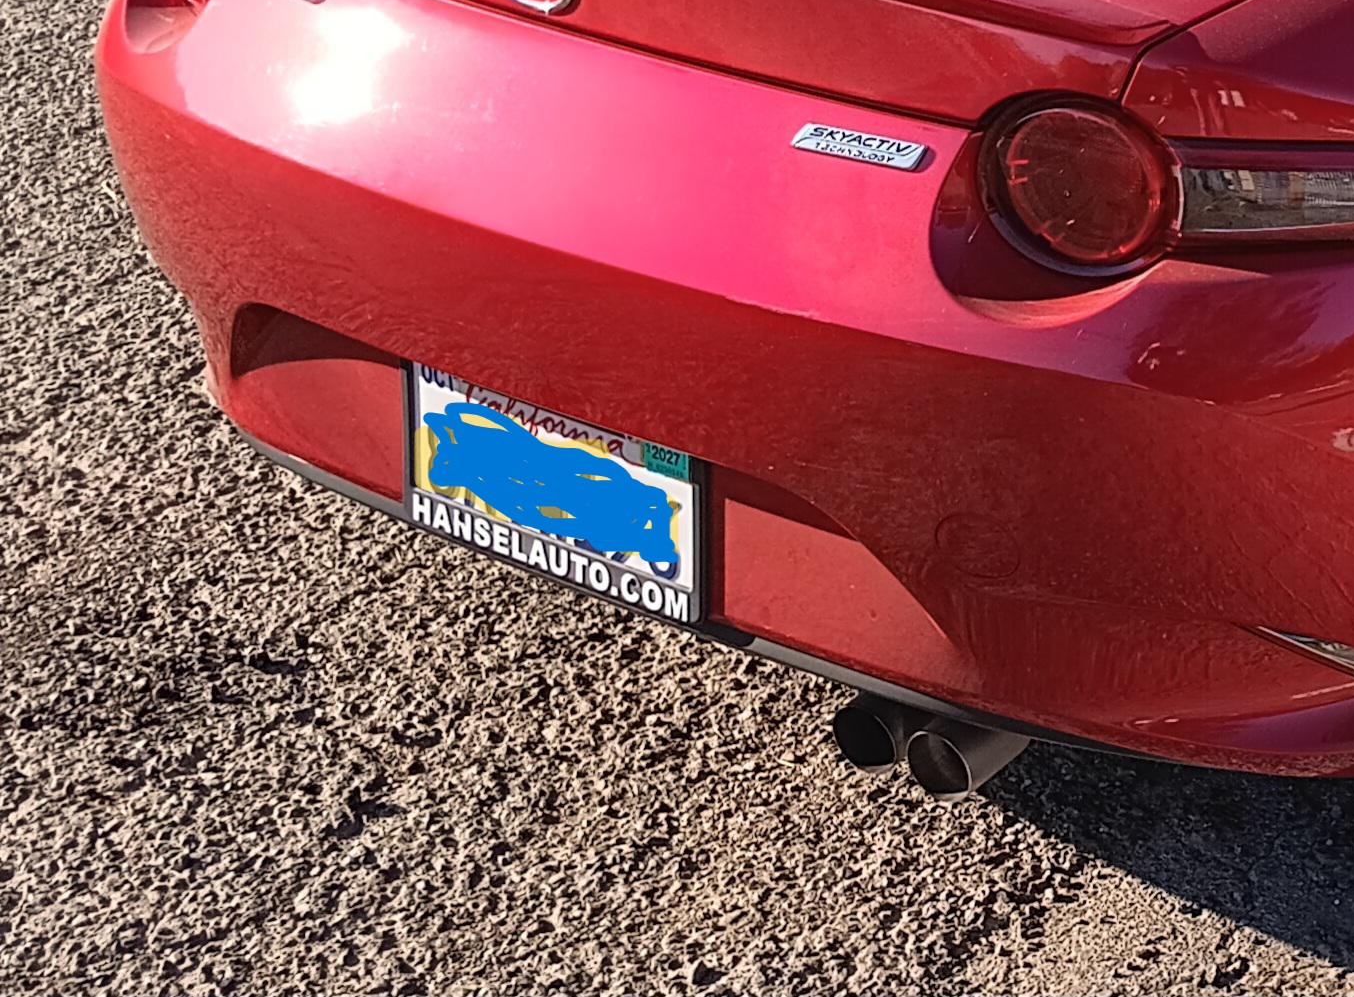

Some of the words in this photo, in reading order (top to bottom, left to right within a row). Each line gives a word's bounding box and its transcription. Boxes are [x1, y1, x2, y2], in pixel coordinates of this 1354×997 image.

[810, 126, 912, 153] SKYACTIV
[651, 444, 681, 466] 2027
[412, 494, 689, 622] HANSELAUTO.COM
